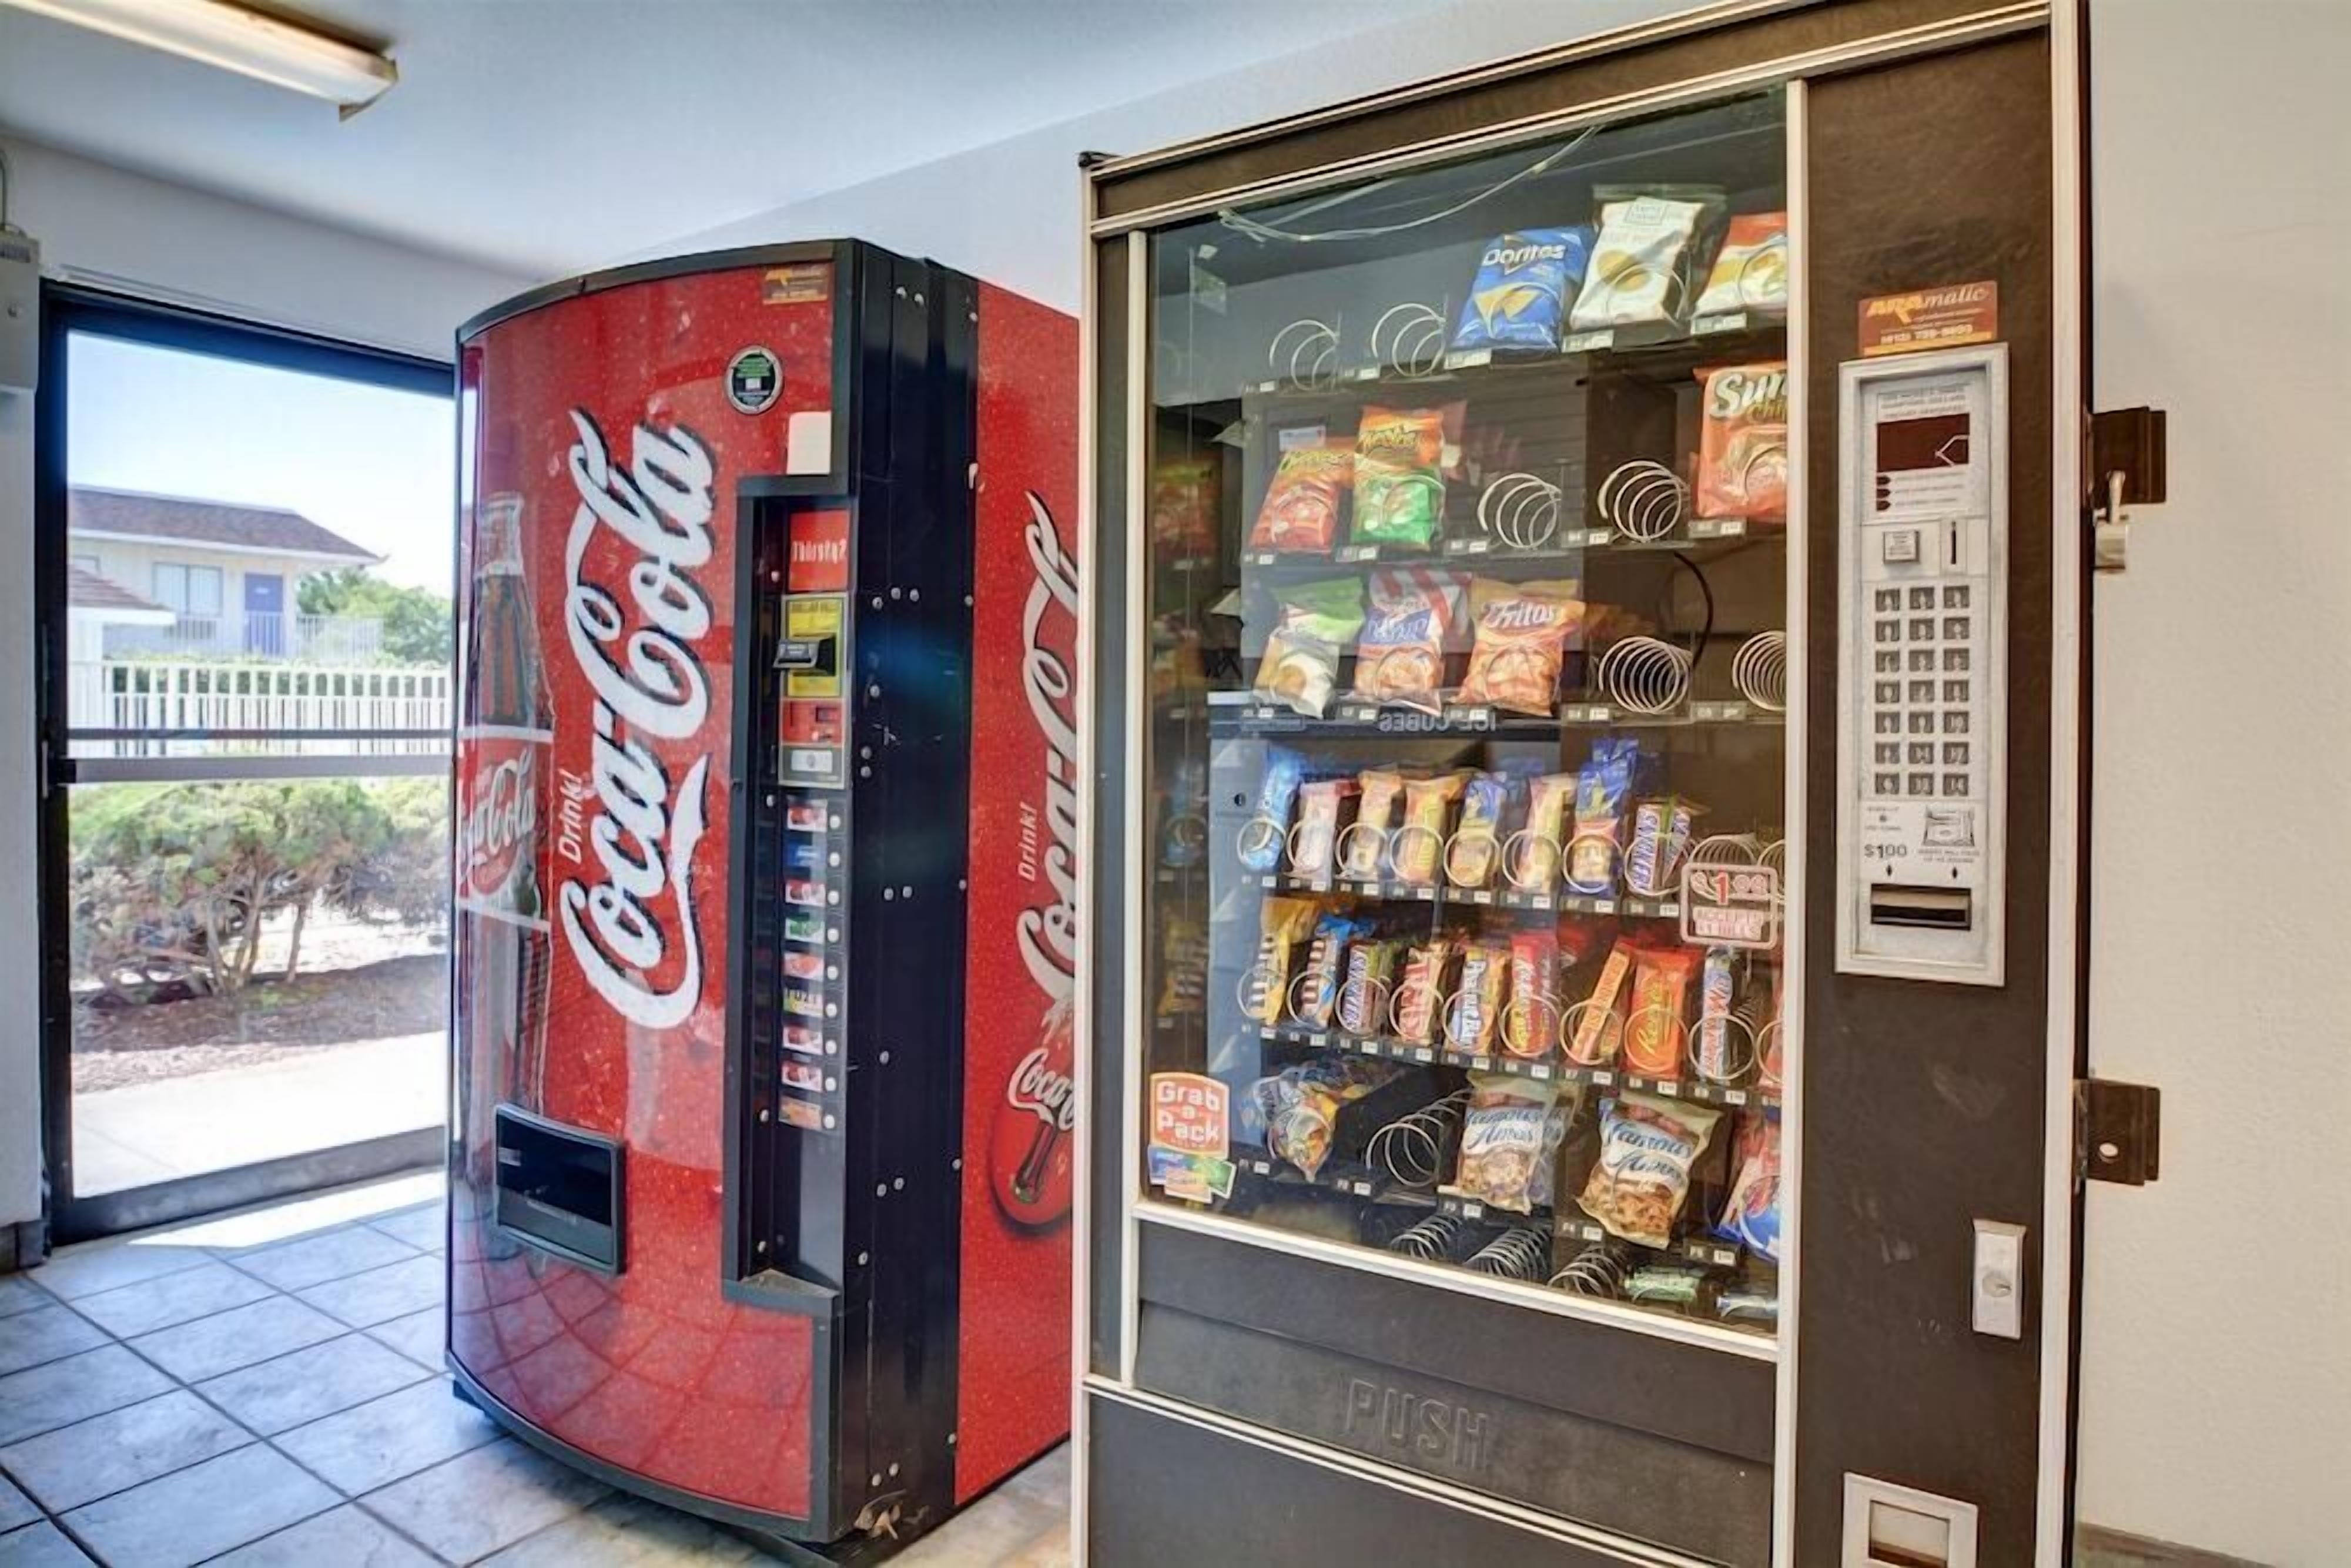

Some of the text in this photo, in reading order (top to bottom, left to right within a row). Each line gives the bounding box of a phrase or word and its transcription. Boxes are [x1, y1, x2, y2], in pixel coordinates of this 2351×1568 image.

[1482, 244, 1566, 267] Doritos
[560, 406, 715, 1029] Coca-Cola
[558, 769, 583, 865] Drink!
[1017, 802, 1038, 883] Drink!
[1157, 1081, 1221, 1112] Grab
[1157, 1108, 1220, 1143] Pack
[1342, 1377, 1491, 1472] PUSH
